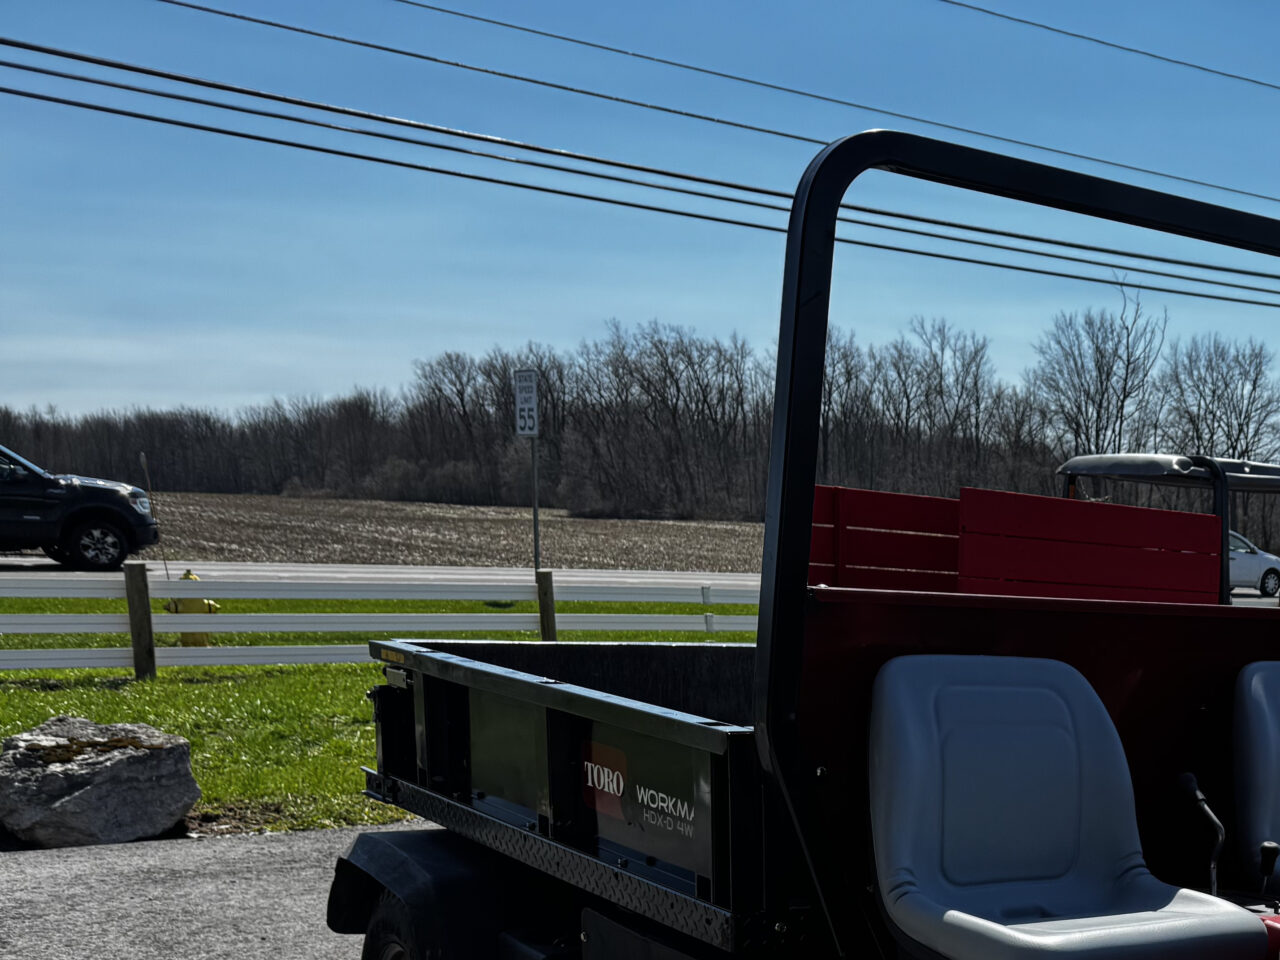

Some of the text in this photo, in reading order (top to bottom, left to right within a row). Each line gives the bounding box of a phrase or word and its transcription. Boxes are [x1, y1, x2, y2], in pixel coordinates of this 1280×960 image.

[519, 408, 535, 431] 55
[584, 761, 624, 797] TORO
[643, 808, 674, 831] HDX-D
